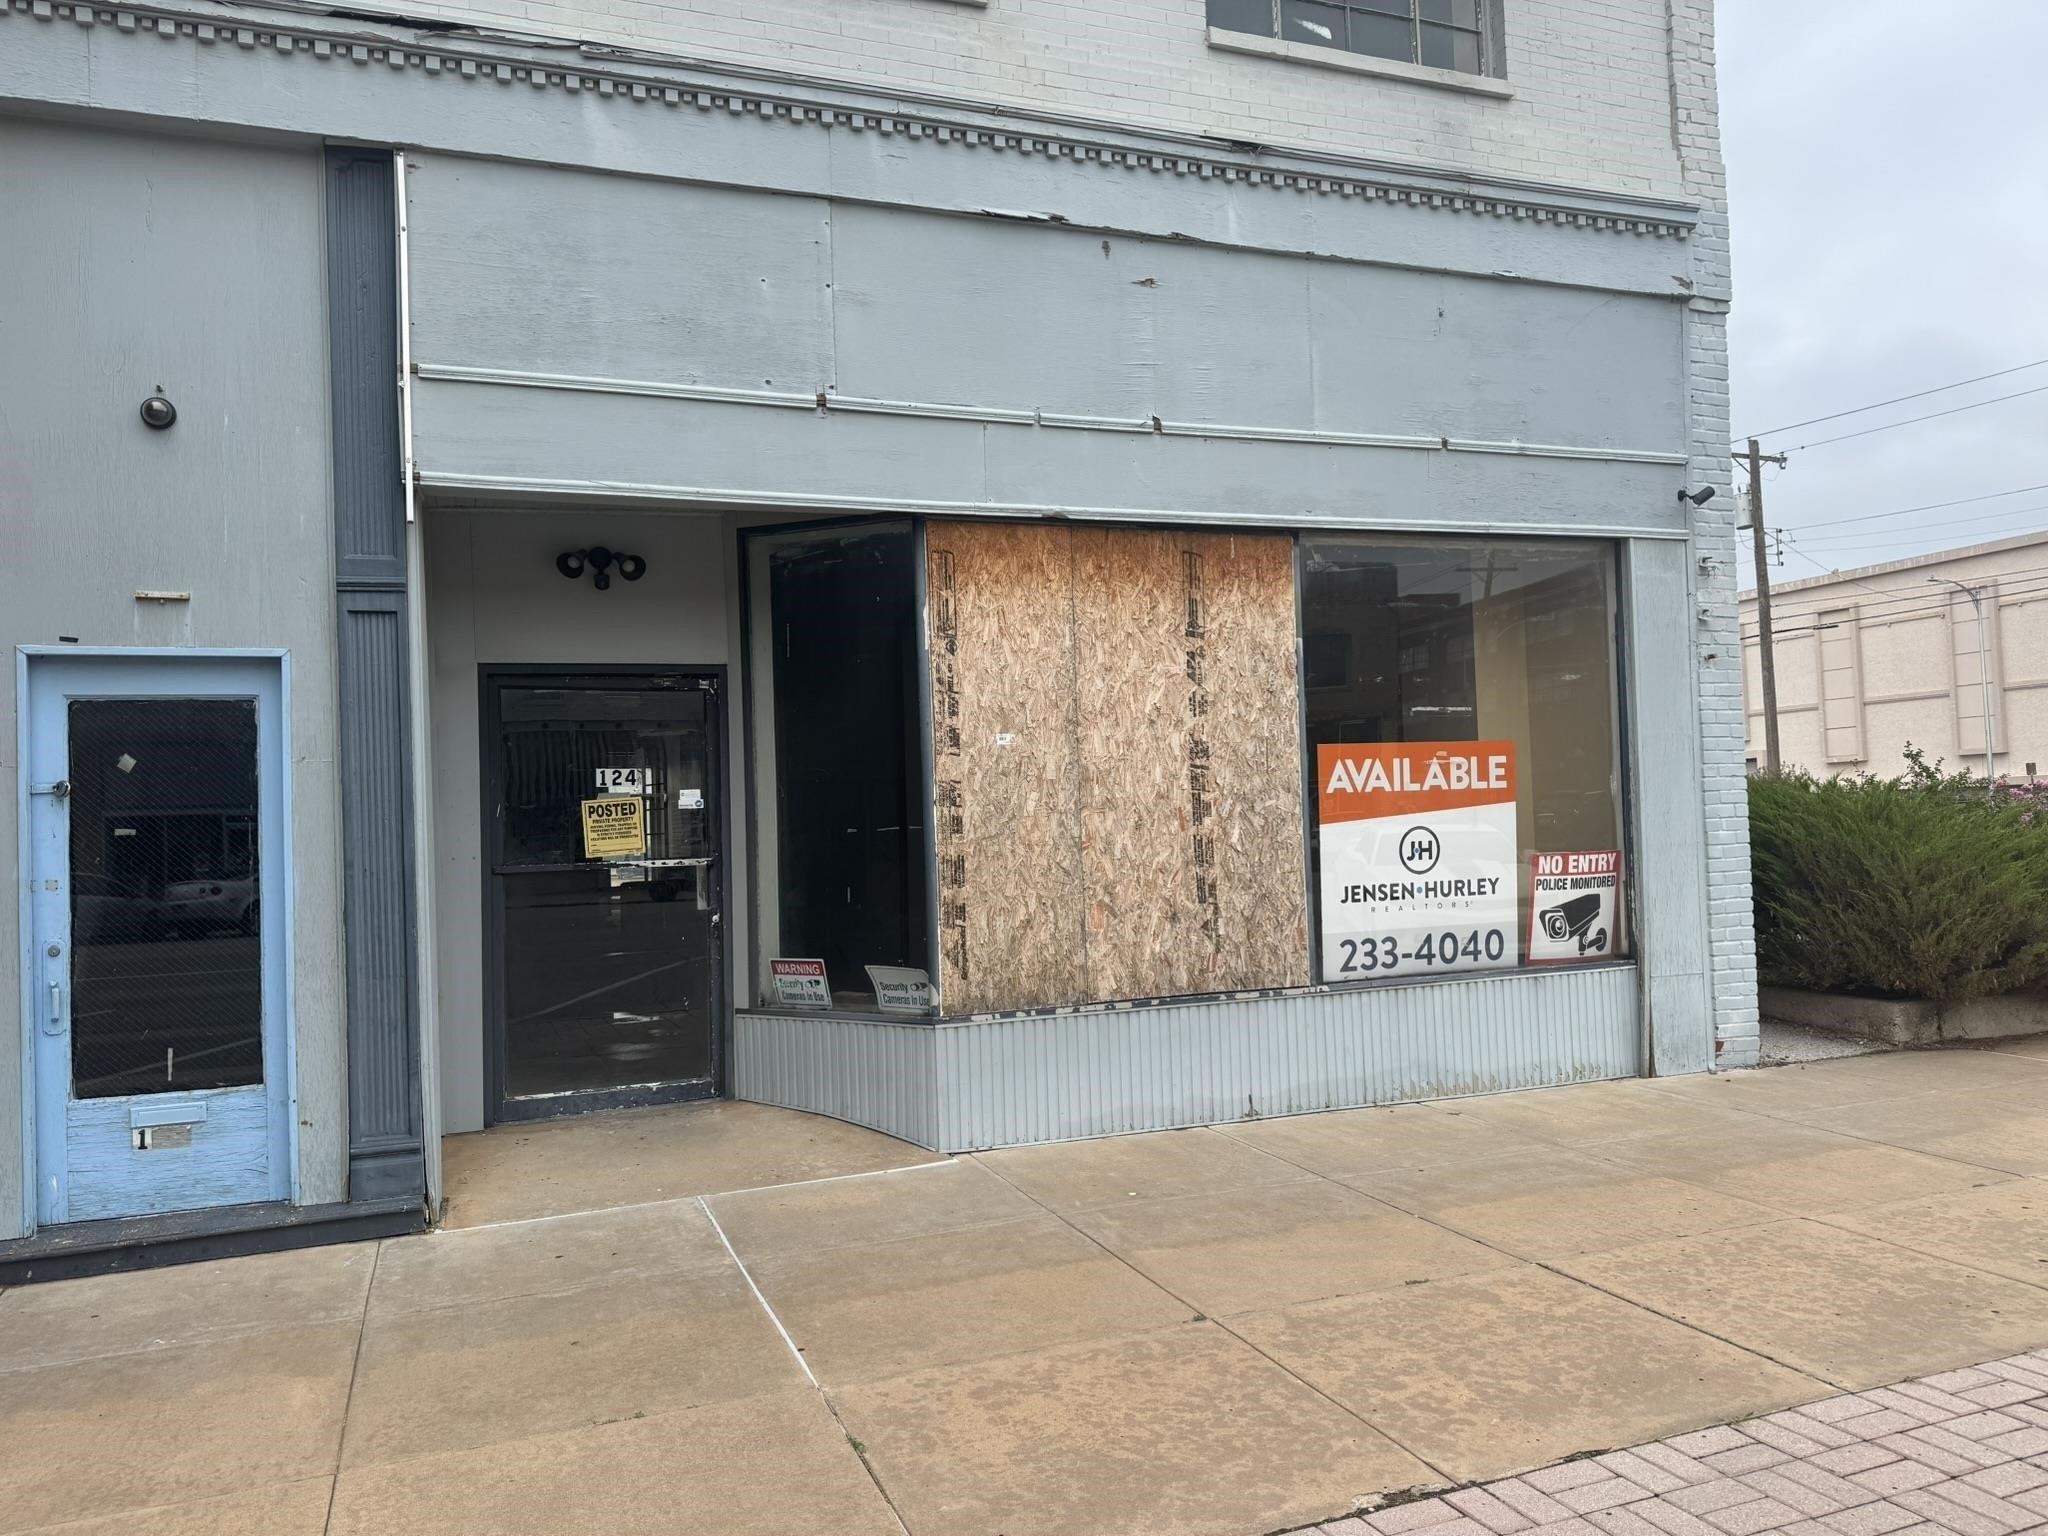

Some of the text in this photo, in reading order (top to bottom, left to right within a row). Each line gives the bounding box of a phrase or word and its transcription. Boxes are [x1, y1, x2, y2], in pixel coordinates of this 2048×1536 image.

[600, 769, 637, 786] 124
[1326, 755, 1507, 793] AVAILABLE
[588, 802, 637, 818] POSTED
[1538, 853, 1616, 875] NO ENTRY
[1340, 877, 1500, 904] JENSEN HURLEY
[1536, 875, 1616, 891] POLICE MONITORED
[1339, 929, 1505, 973] 233-4040
[775, 963, 820, 975] WARNING
[879, 982, 908, 993] Security
[882, 993, 910, 1005] Cameras
[918, 995, 930, 1006] Use
[138, 1129, 148, 1150] 1
